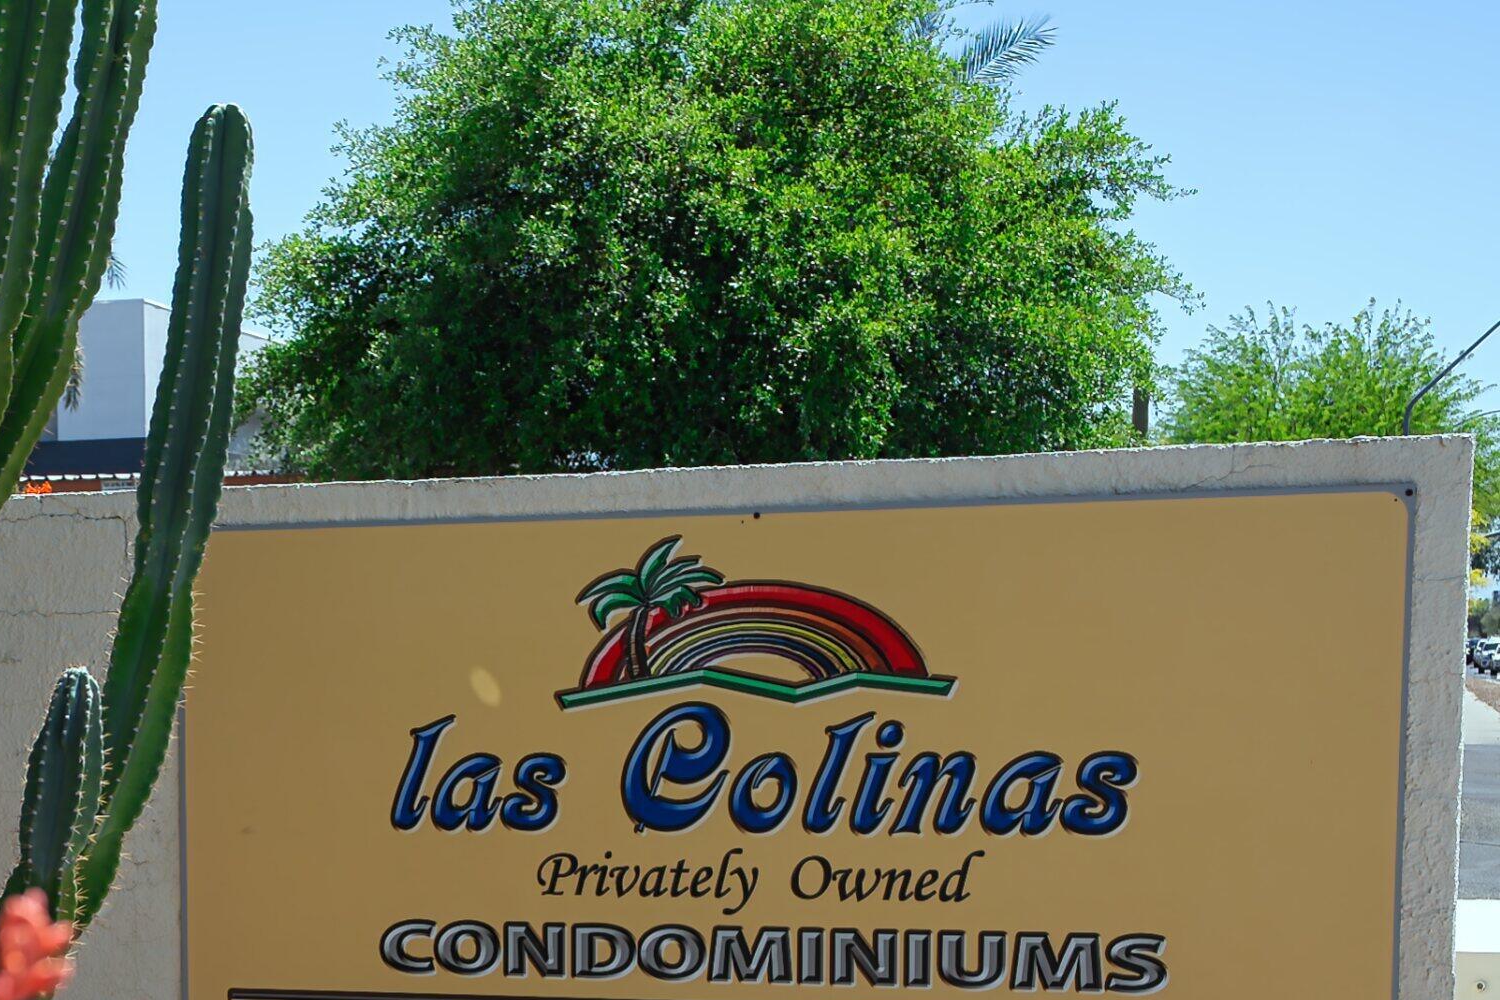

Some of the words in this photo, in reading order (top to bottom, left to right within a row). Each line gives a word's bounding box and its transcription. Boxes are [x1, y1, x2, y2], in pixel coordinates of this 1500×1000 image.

[389, 714, 567, 833] las
[621, 701, 1140, 835] Colinas
[536, 847, 759, 915] Privately
[789, 849, 985, 903] Owned
[380, 919, 1170, 993] CONDOMINIUMS
